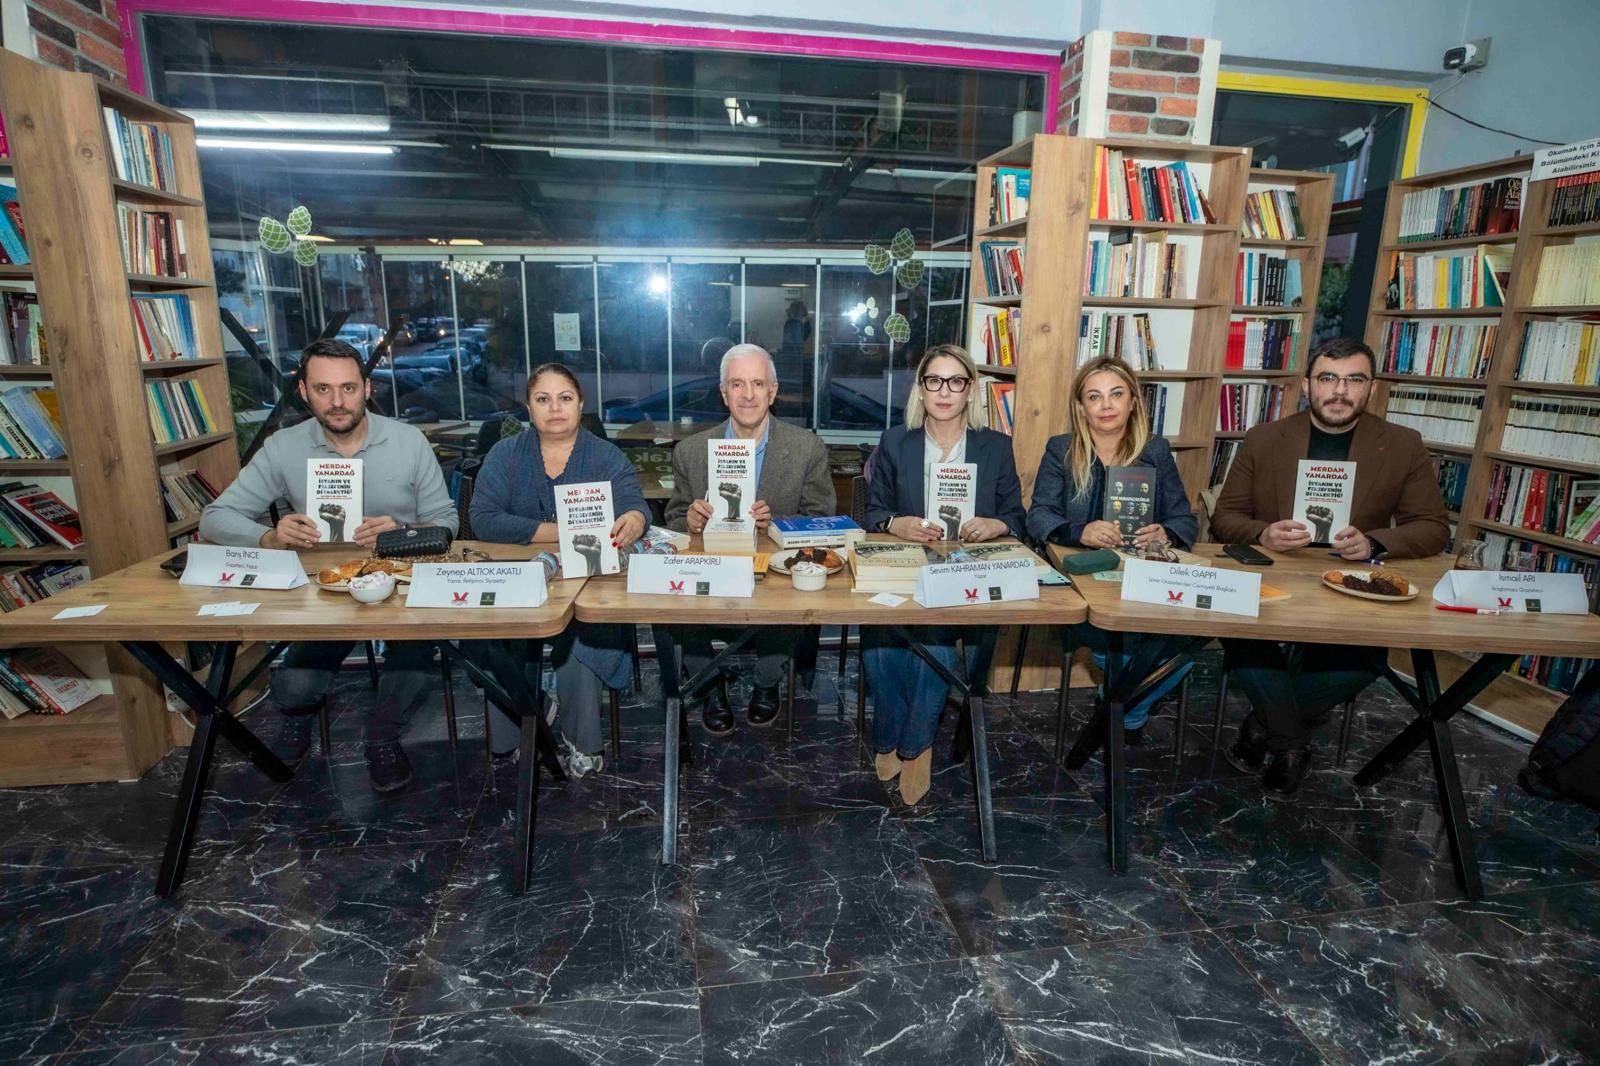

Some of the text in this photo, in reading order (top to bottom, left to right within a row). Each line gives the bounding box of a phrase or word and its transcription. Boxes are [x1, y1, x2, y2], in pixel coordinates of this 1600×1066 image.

[1548, 146, 1577, 157] Okumak
[1580, 143, 1594, 151] için
[1541, 153, 1589, 166] Bölümündeki
[1552, 161, 1596, 174] Alabilirsiniz
[1305, 472, 1348, 480] YANARDAĞ
[563, 494, 606, 504] YANARDAĞ
[226, 549, 259, 560] Barış İNCE
[663, 556, 721, 566] Zafer ARAPKİRLİ
[436, 567, 522, 577] Zeynep ALTIOK AKATLI
[929, 559, 1031, 575] Sevim KAHRAMAN YANARDAĞ
[1169, 566, 1217, 580] Dilek GAPPİ
[1523, 574, 1536, 583] ARI
